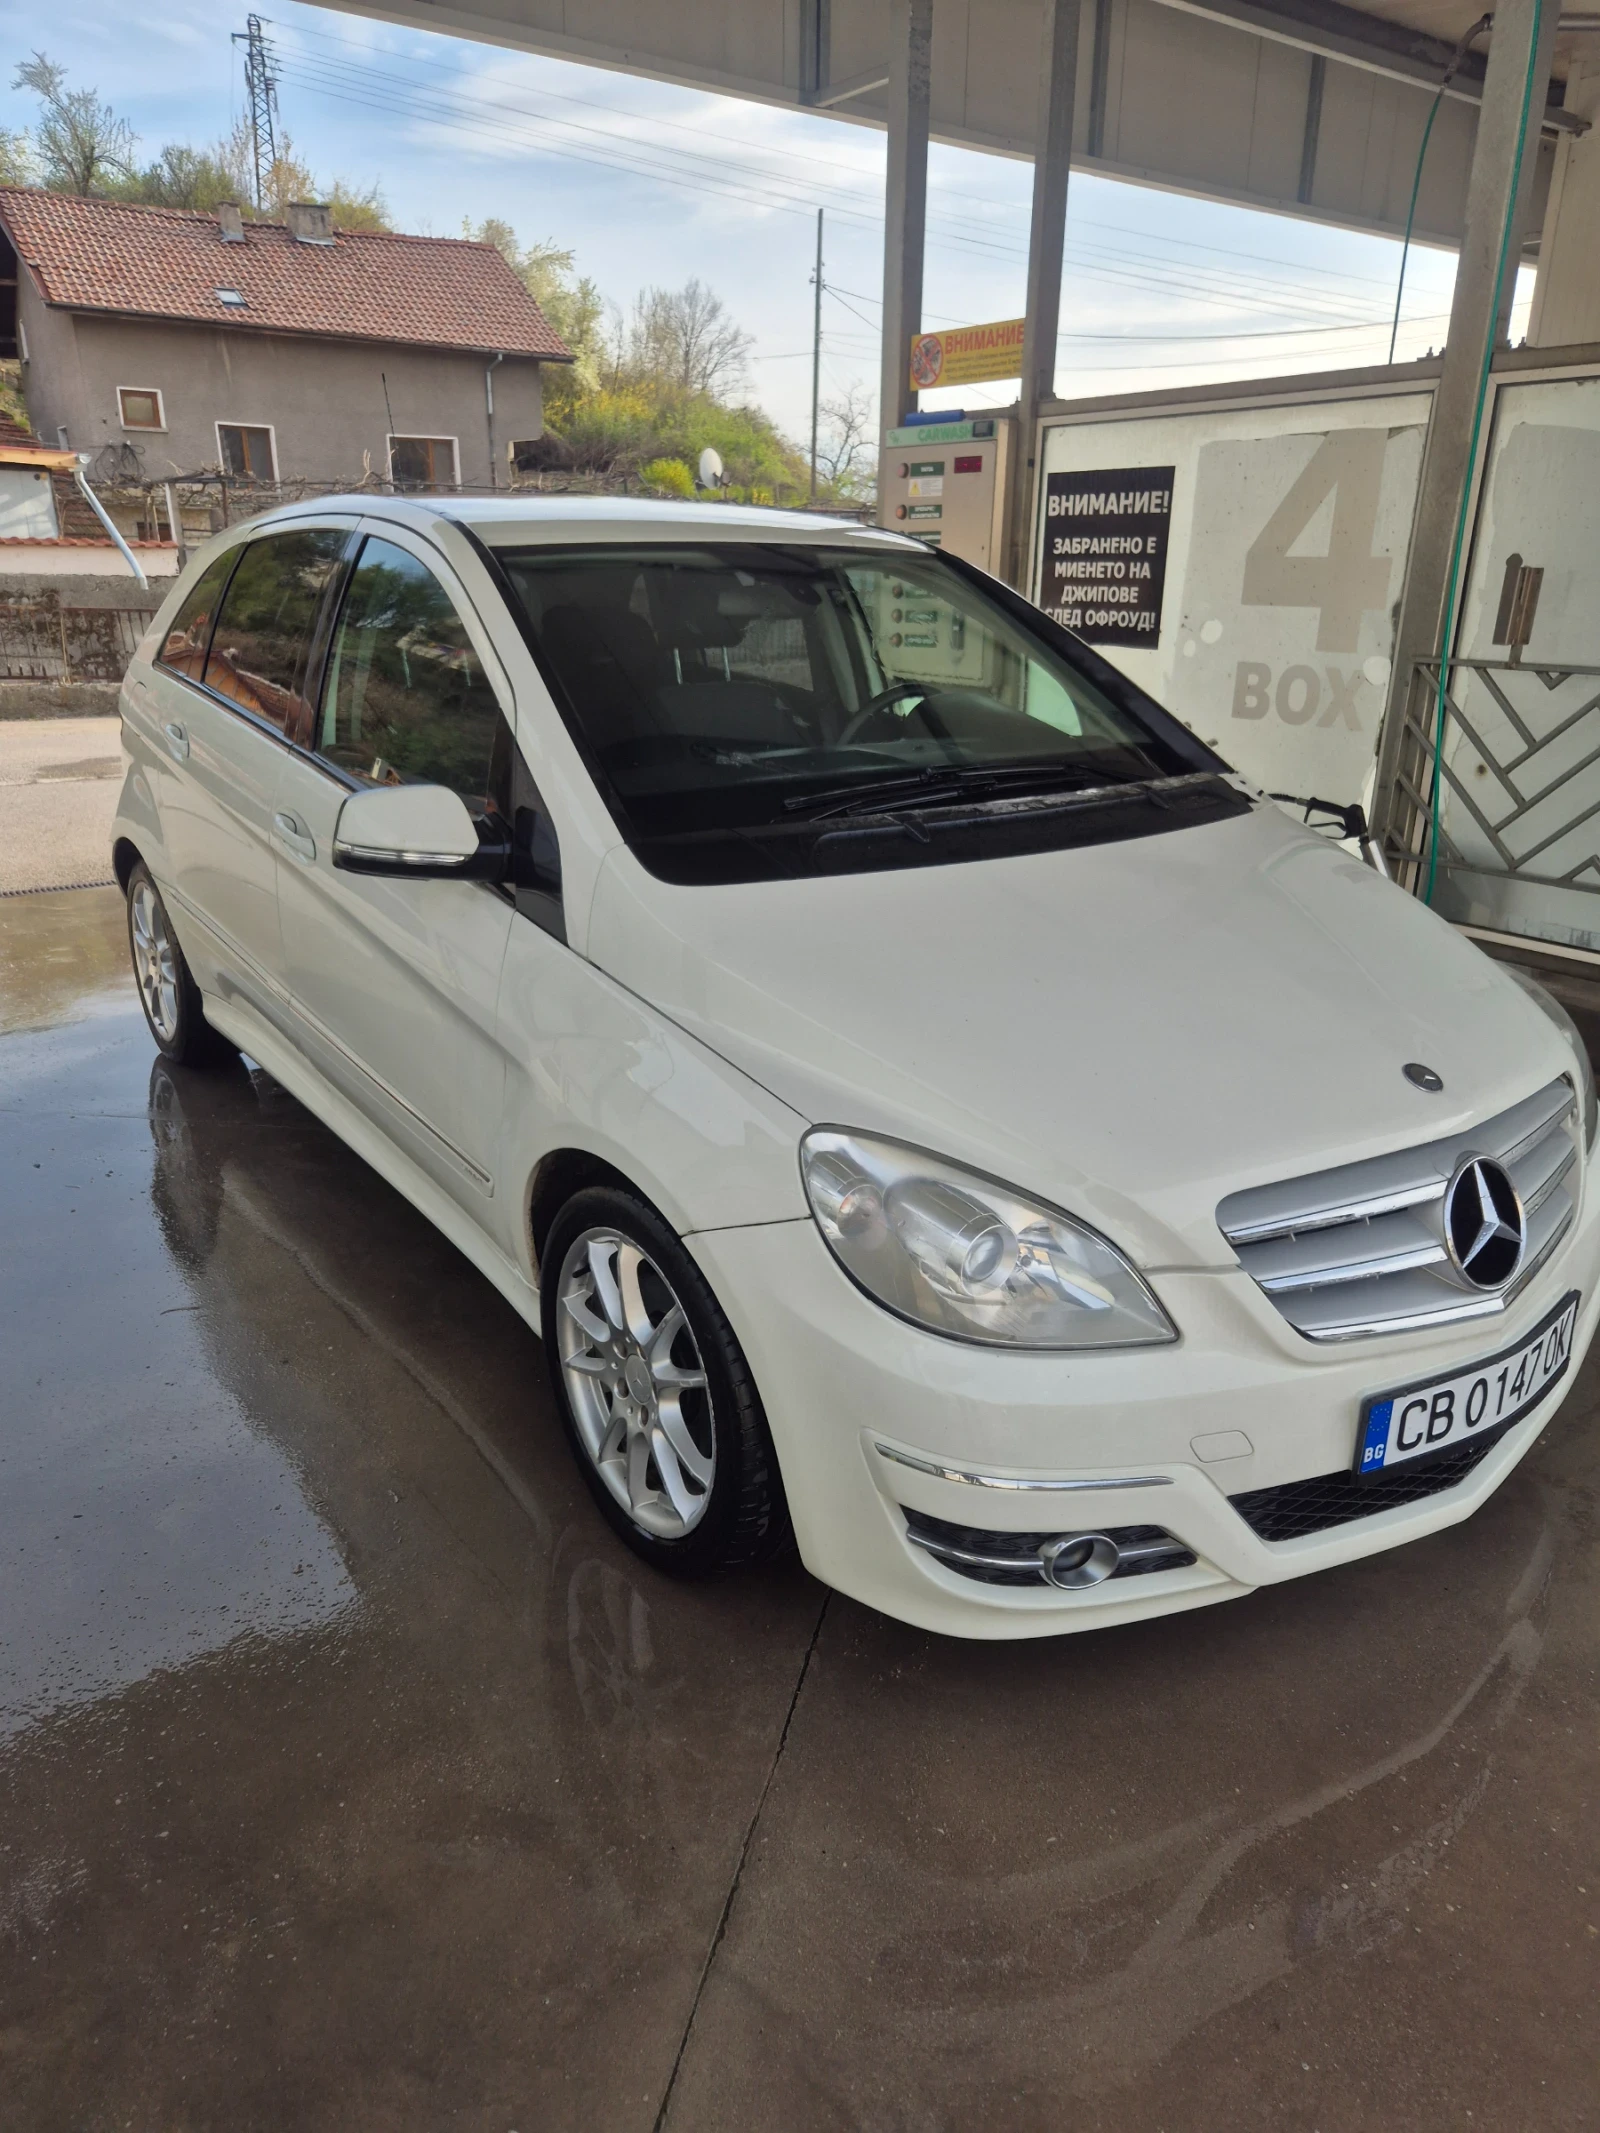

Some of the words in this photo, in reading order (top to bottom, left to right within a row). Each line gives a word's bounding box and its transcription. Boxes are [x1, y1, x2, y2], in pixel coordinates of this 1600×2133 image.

[945, 323, 1024, 355] ВНИМАНИЕ
[1048, 490, 1170, 516] ВНИМАНИЕ!
[1053, 536, 1143, 555] ЗАБРАНЕНО
[1146, 536, 1157, 554] Е
[1241, 428, 1393, 653] 4
[1054, 561, 1125, 579] МИЕНЕТО
[1129, 561, 1151, 579] НА
[1061, 585, 1139, 605] ДЖИПОВЕ
[1085, 609, 1156, 632] ОФРОУД!
[1231, 661, 1363, 731] BOX
[1396, 1389, 1455, 1451] CB
[1465, 1339, 1544, 1428] 0147
[1364, 1443, 1385, 1463] BG
